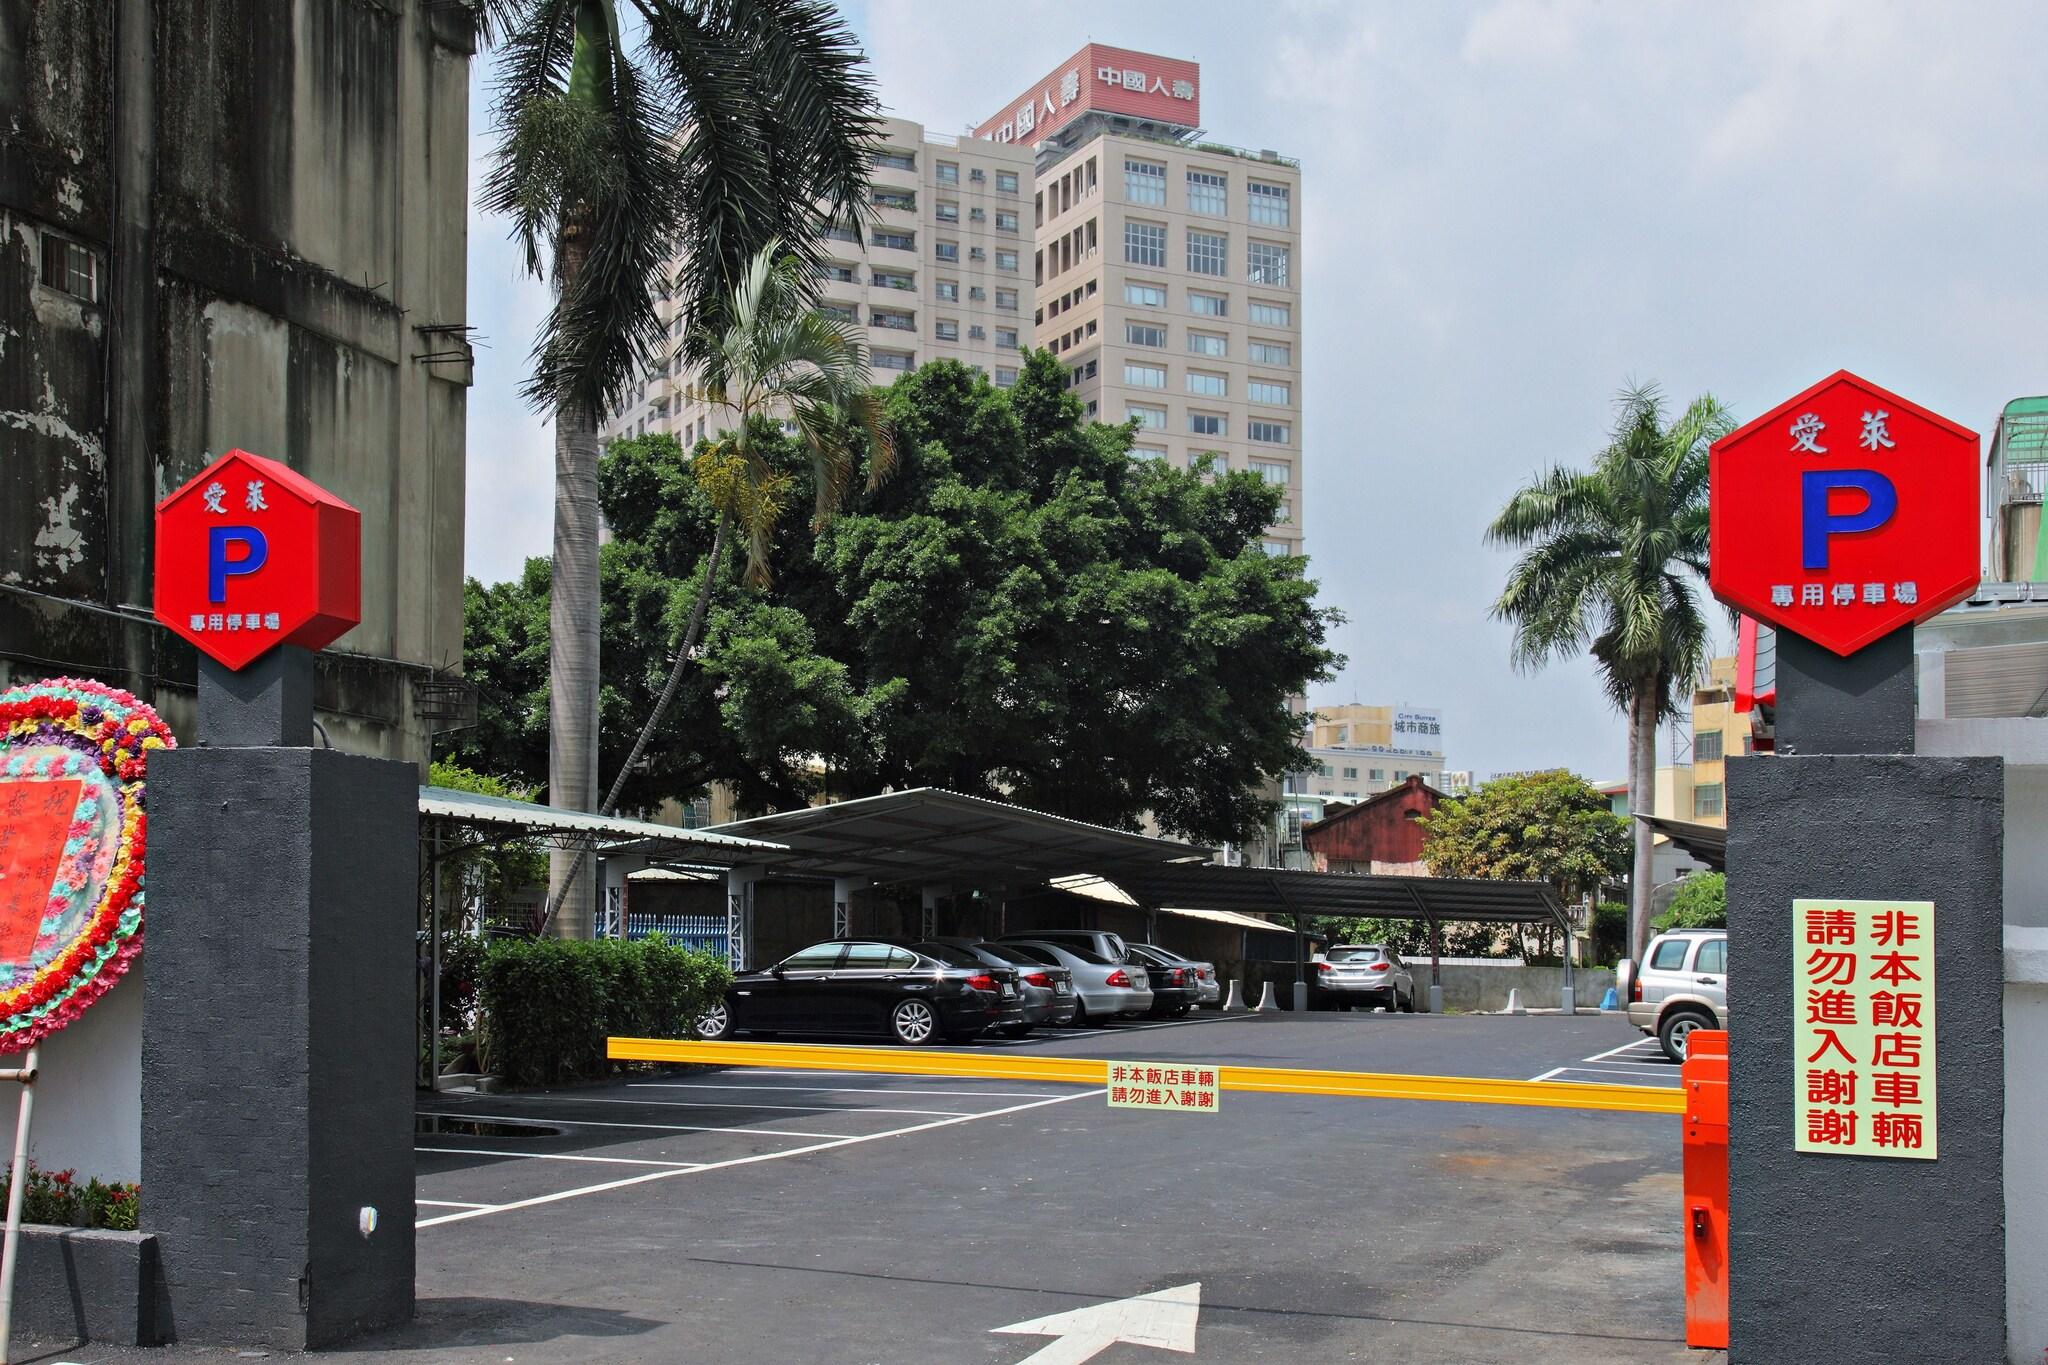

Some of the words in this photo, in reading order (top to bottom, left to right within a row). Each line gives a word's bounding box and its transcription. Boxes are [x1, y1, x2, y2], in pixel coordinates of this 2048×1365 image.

[1098, 66, 1194, 101] 中國人壽
[1789, 410, 1896, 453] 愛萊
[204, 480, 268, 513] 愛萊
[1802, 469, 1897, 569] P
[208, 526, 268, 603] P
[1771, 582, 1918, 606] 專用停車場
[190, 613, 280, 631] 專用停車場
[1394, 720, 1440, 735] 城市商旅
[1805, 909, 1859, 1145] 請勿進入謝謝
[1870, 910, 1922, 1148] 非本飯店車輛
[1112, 1066, 1214, 1087] 非本飯店車輛
[1112, 1086, 1214, 1107] 請勿進入謝謝
